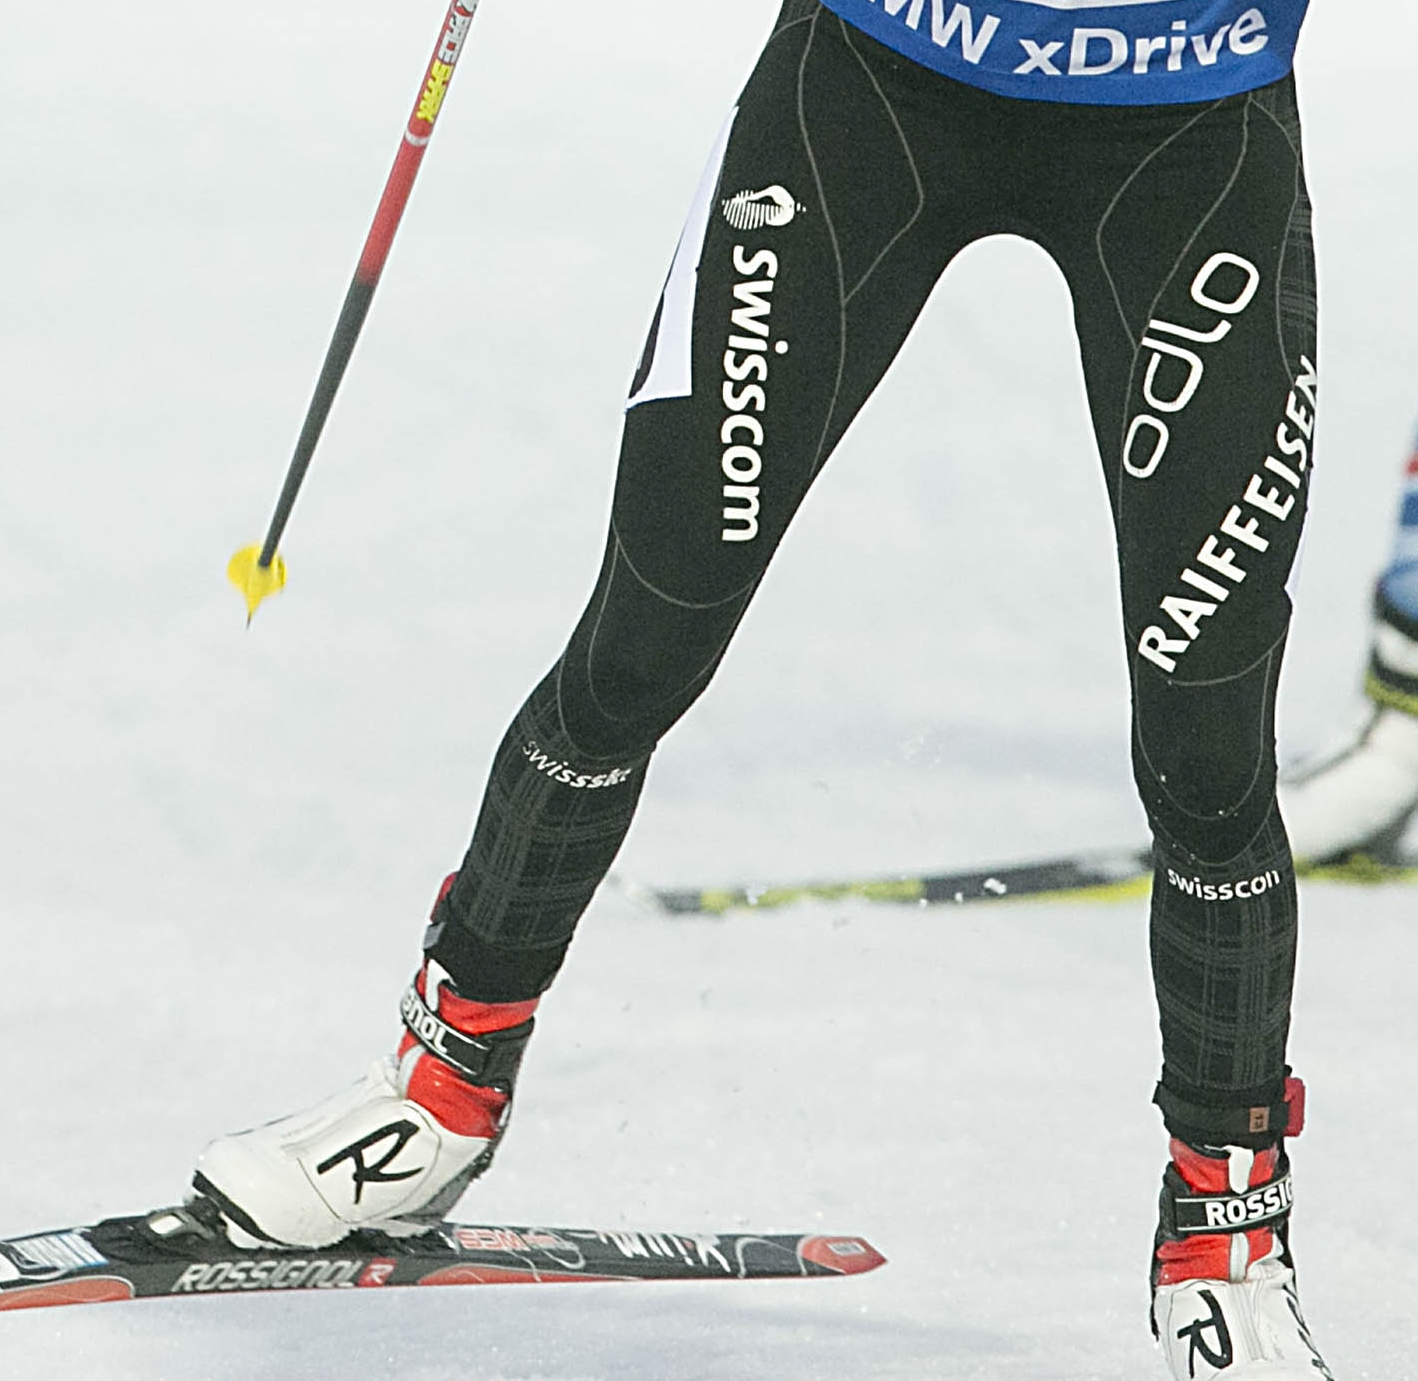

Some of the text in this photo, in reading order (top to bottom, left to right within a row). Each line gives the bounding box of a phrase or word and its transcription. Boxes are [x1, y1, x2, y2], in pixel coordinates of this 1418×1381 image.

[1013, 7, 1269, 76] xDrive
[720, 245, 789, 542] swisscom
[1122, 251, 1260, 479] odlo
[1138, 354, 1320, 673] RAIFFEISEN
[171, 1259, 364, 1293] ROSSIGNOL
